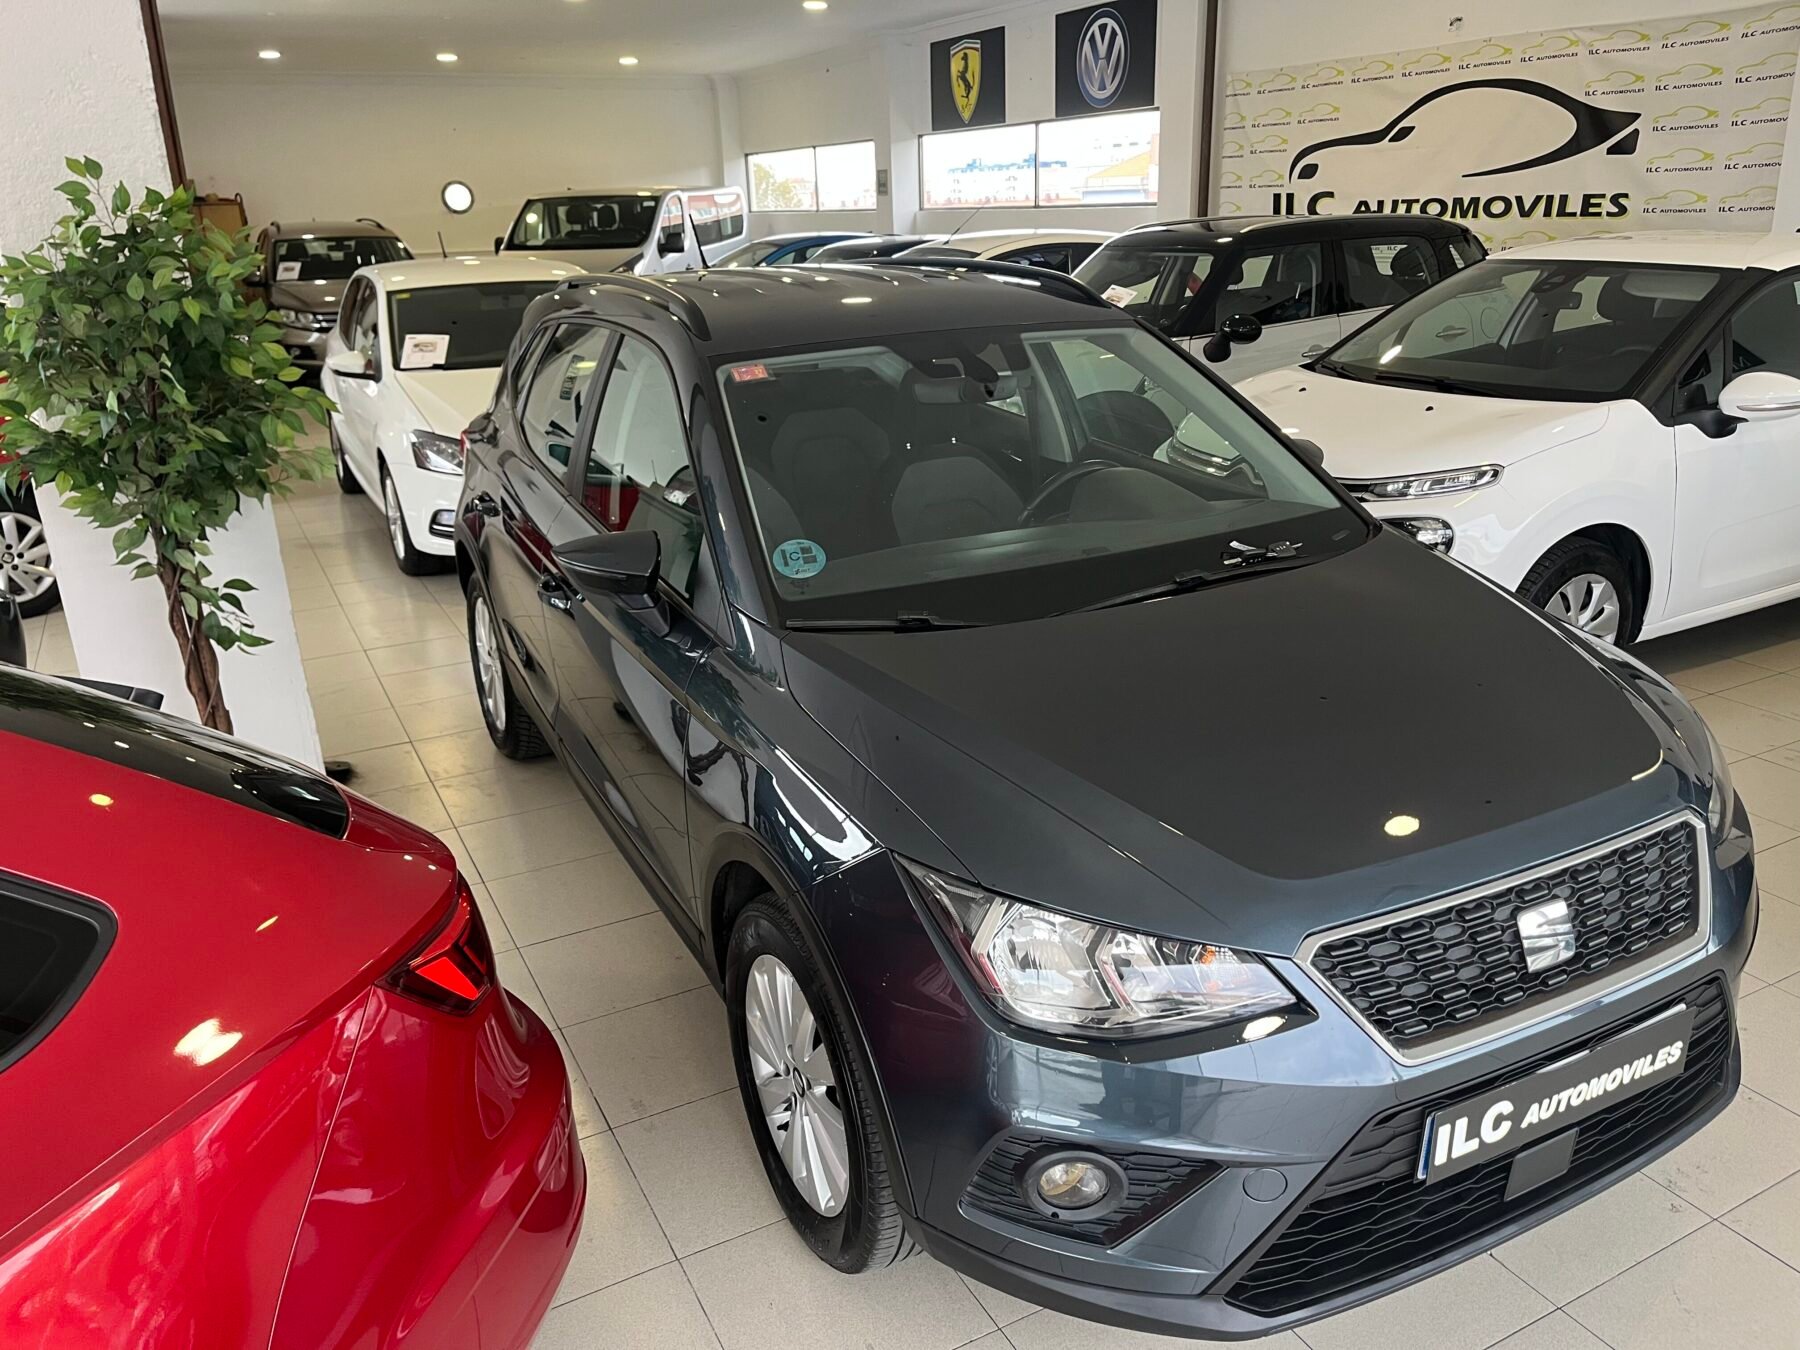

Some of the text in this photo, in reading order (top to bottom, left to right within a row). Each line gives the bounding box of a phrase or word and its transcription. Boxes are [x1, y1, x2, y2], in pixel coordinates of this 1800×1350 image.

[1679, 37, 1728, 47] AUTOMOVILES
[1672, 81, 1722, 89] AUTOMOVILES
[1272, 191, 1629, 219] ILC AUTOMOVILES
[1433, 1041, 1684, 1166] ILC AUTOMOVILES
